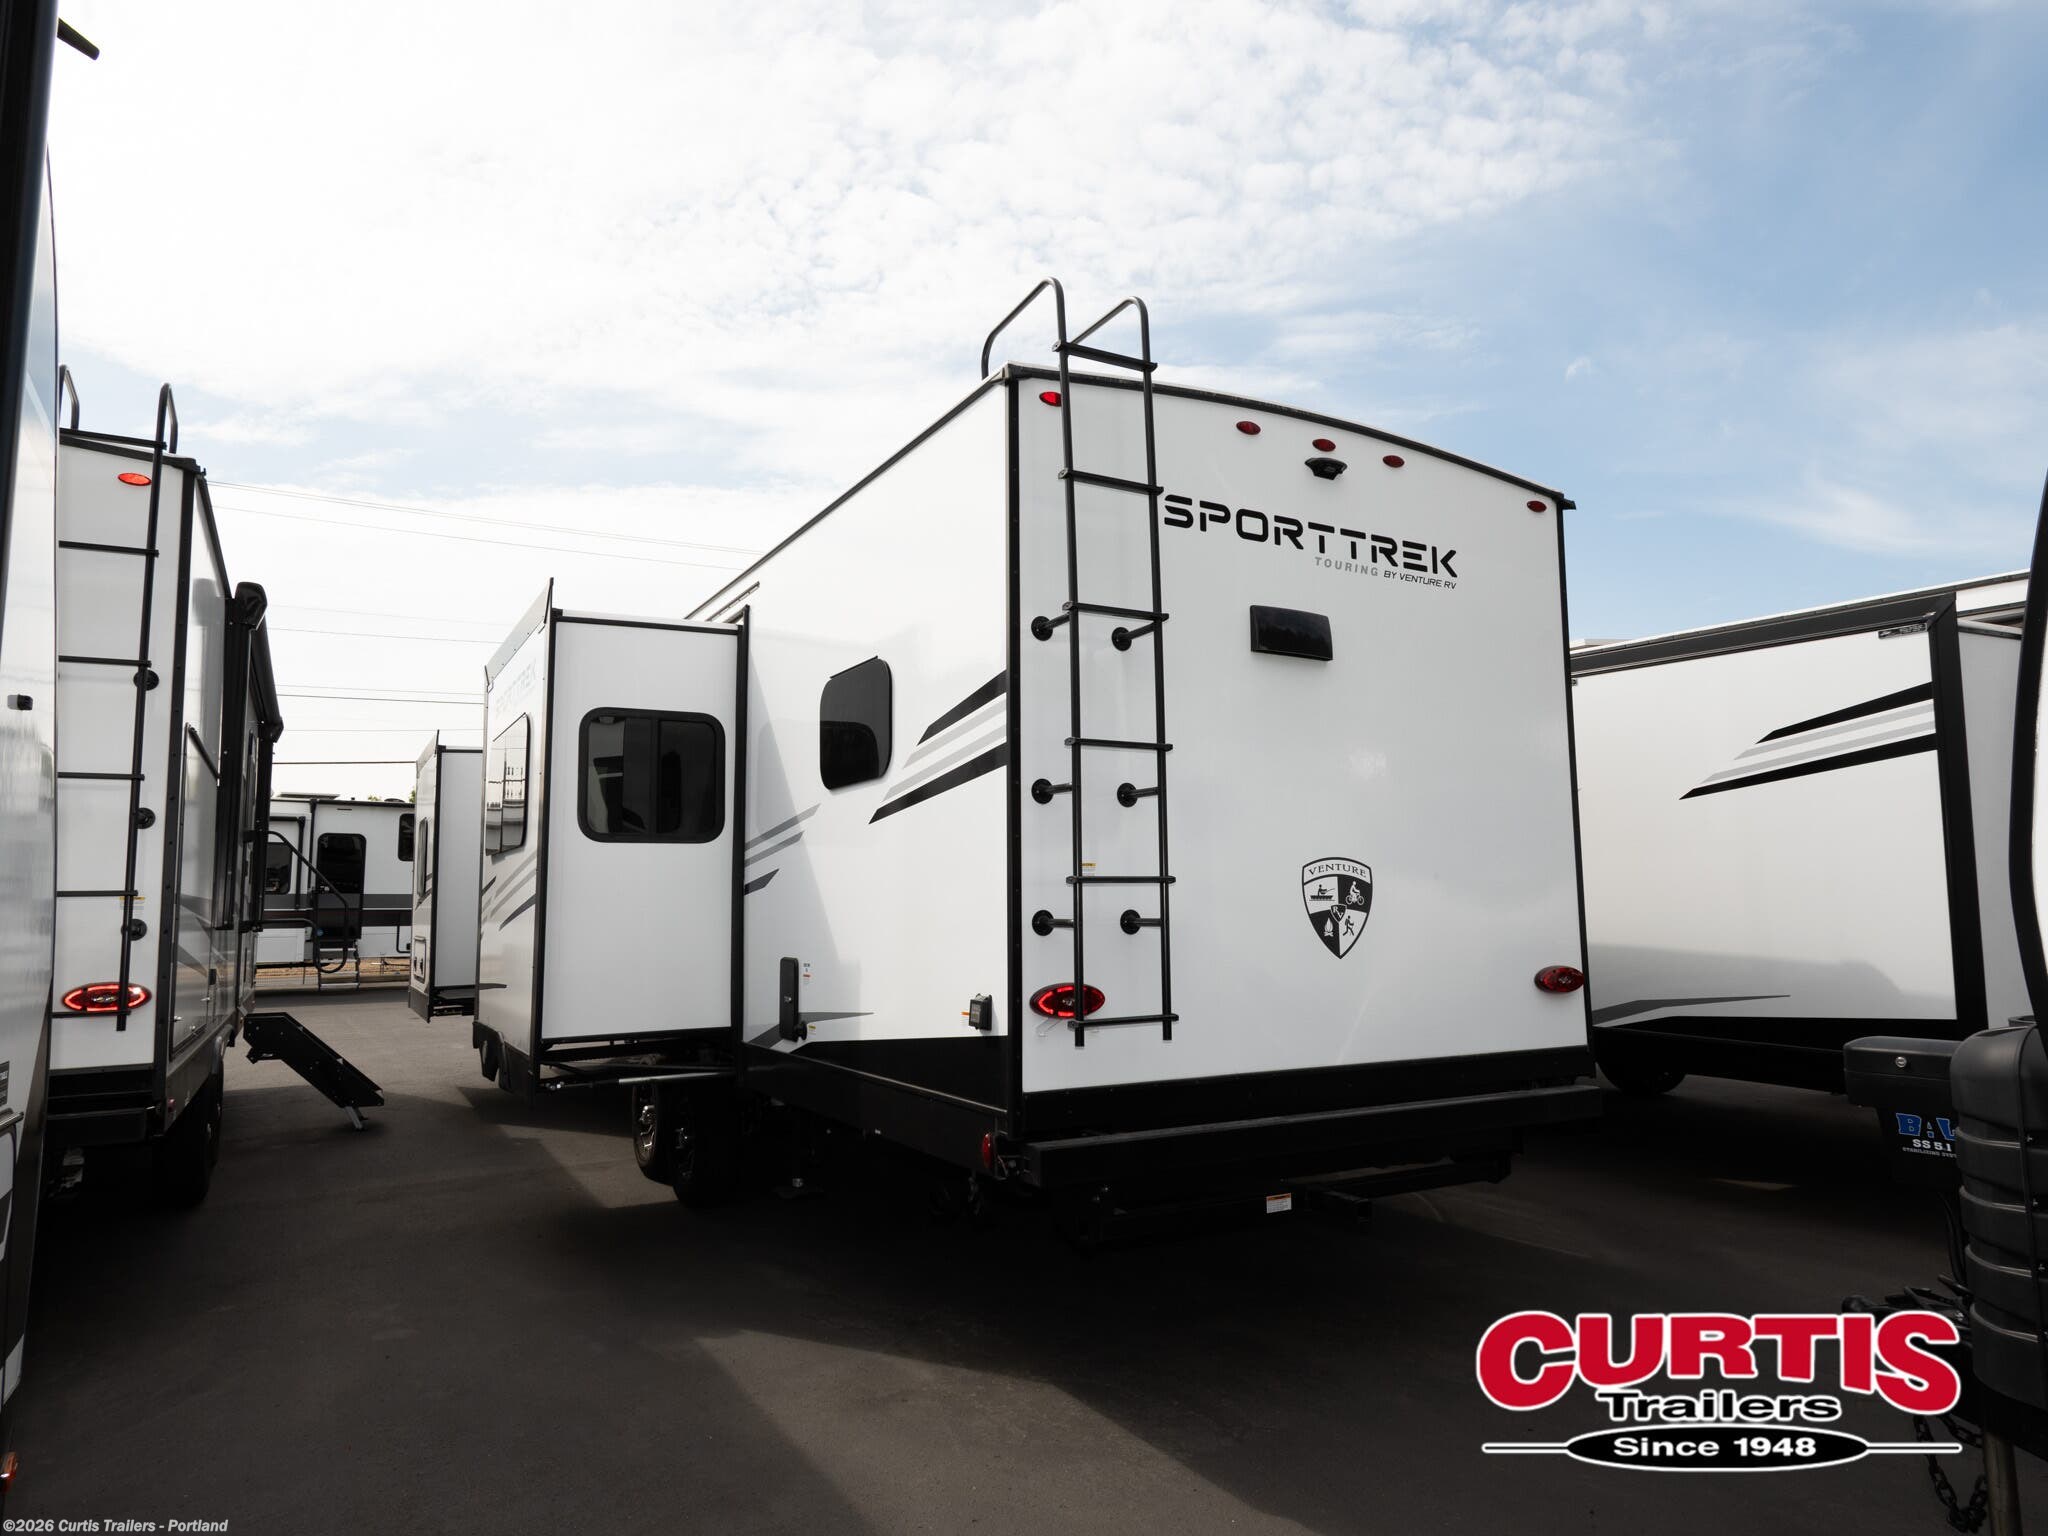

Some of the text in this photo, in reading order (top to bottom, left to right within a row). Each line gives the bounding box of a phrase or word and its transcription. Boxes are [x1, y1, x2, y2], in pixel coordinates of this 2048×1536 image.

[1164, 494, 1458, 578] SPORTTREK
[1314, 556, 1457, 590] TOURING BY VENTURE RV
[1308, 863, 1367, 878] VENTURE
[1912, 1138, 1931, 1149] SS
